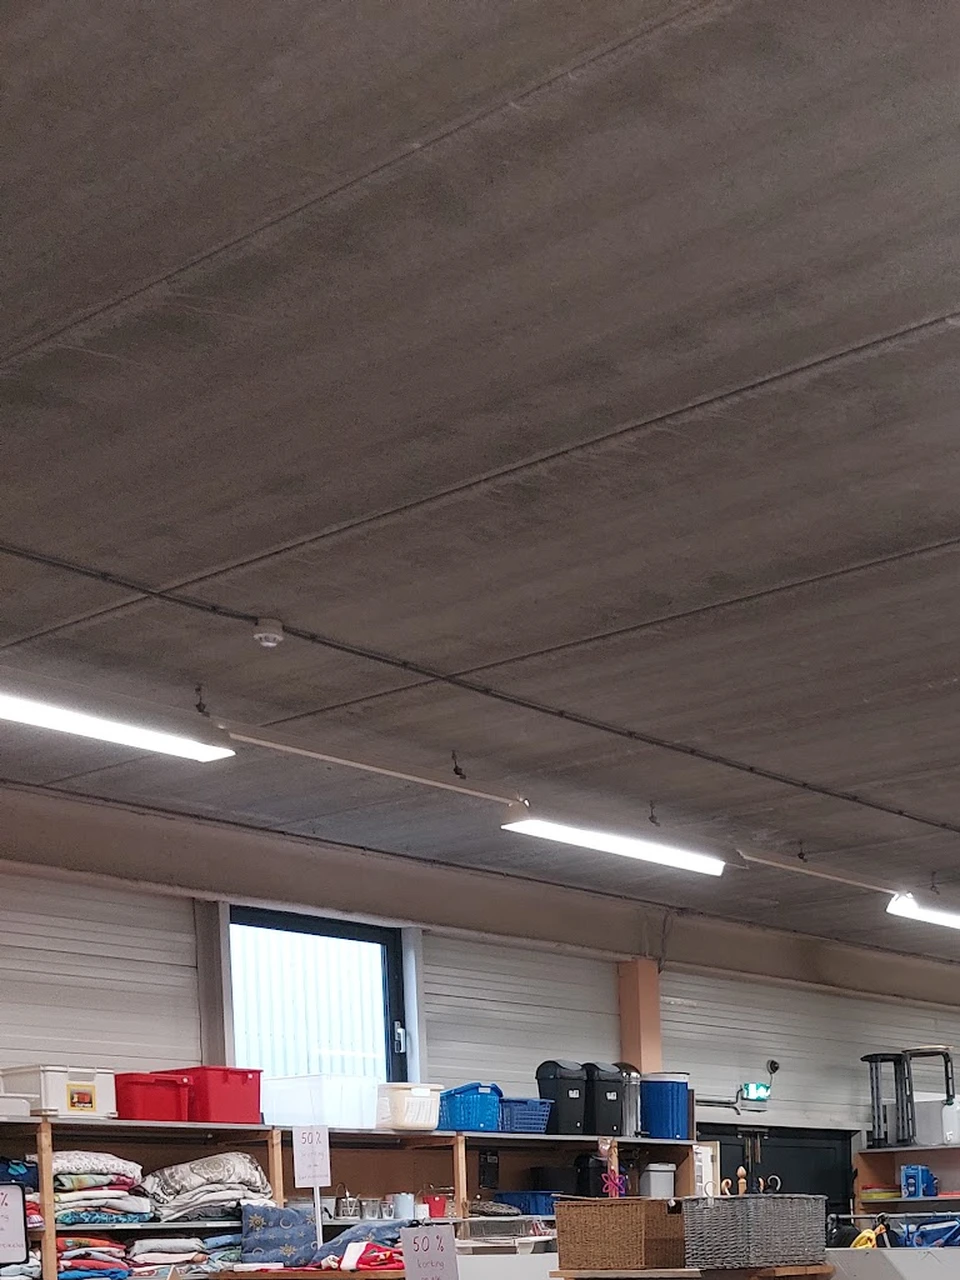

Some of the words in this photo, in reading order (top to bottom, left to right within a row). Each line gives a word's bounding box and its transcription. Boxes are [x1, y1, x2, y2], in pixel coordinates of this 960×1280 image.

[301, 1131, 313, 1145] 50
[412, 1235, 430, 1252] 50
[435, 1234, 445, 1252] %
